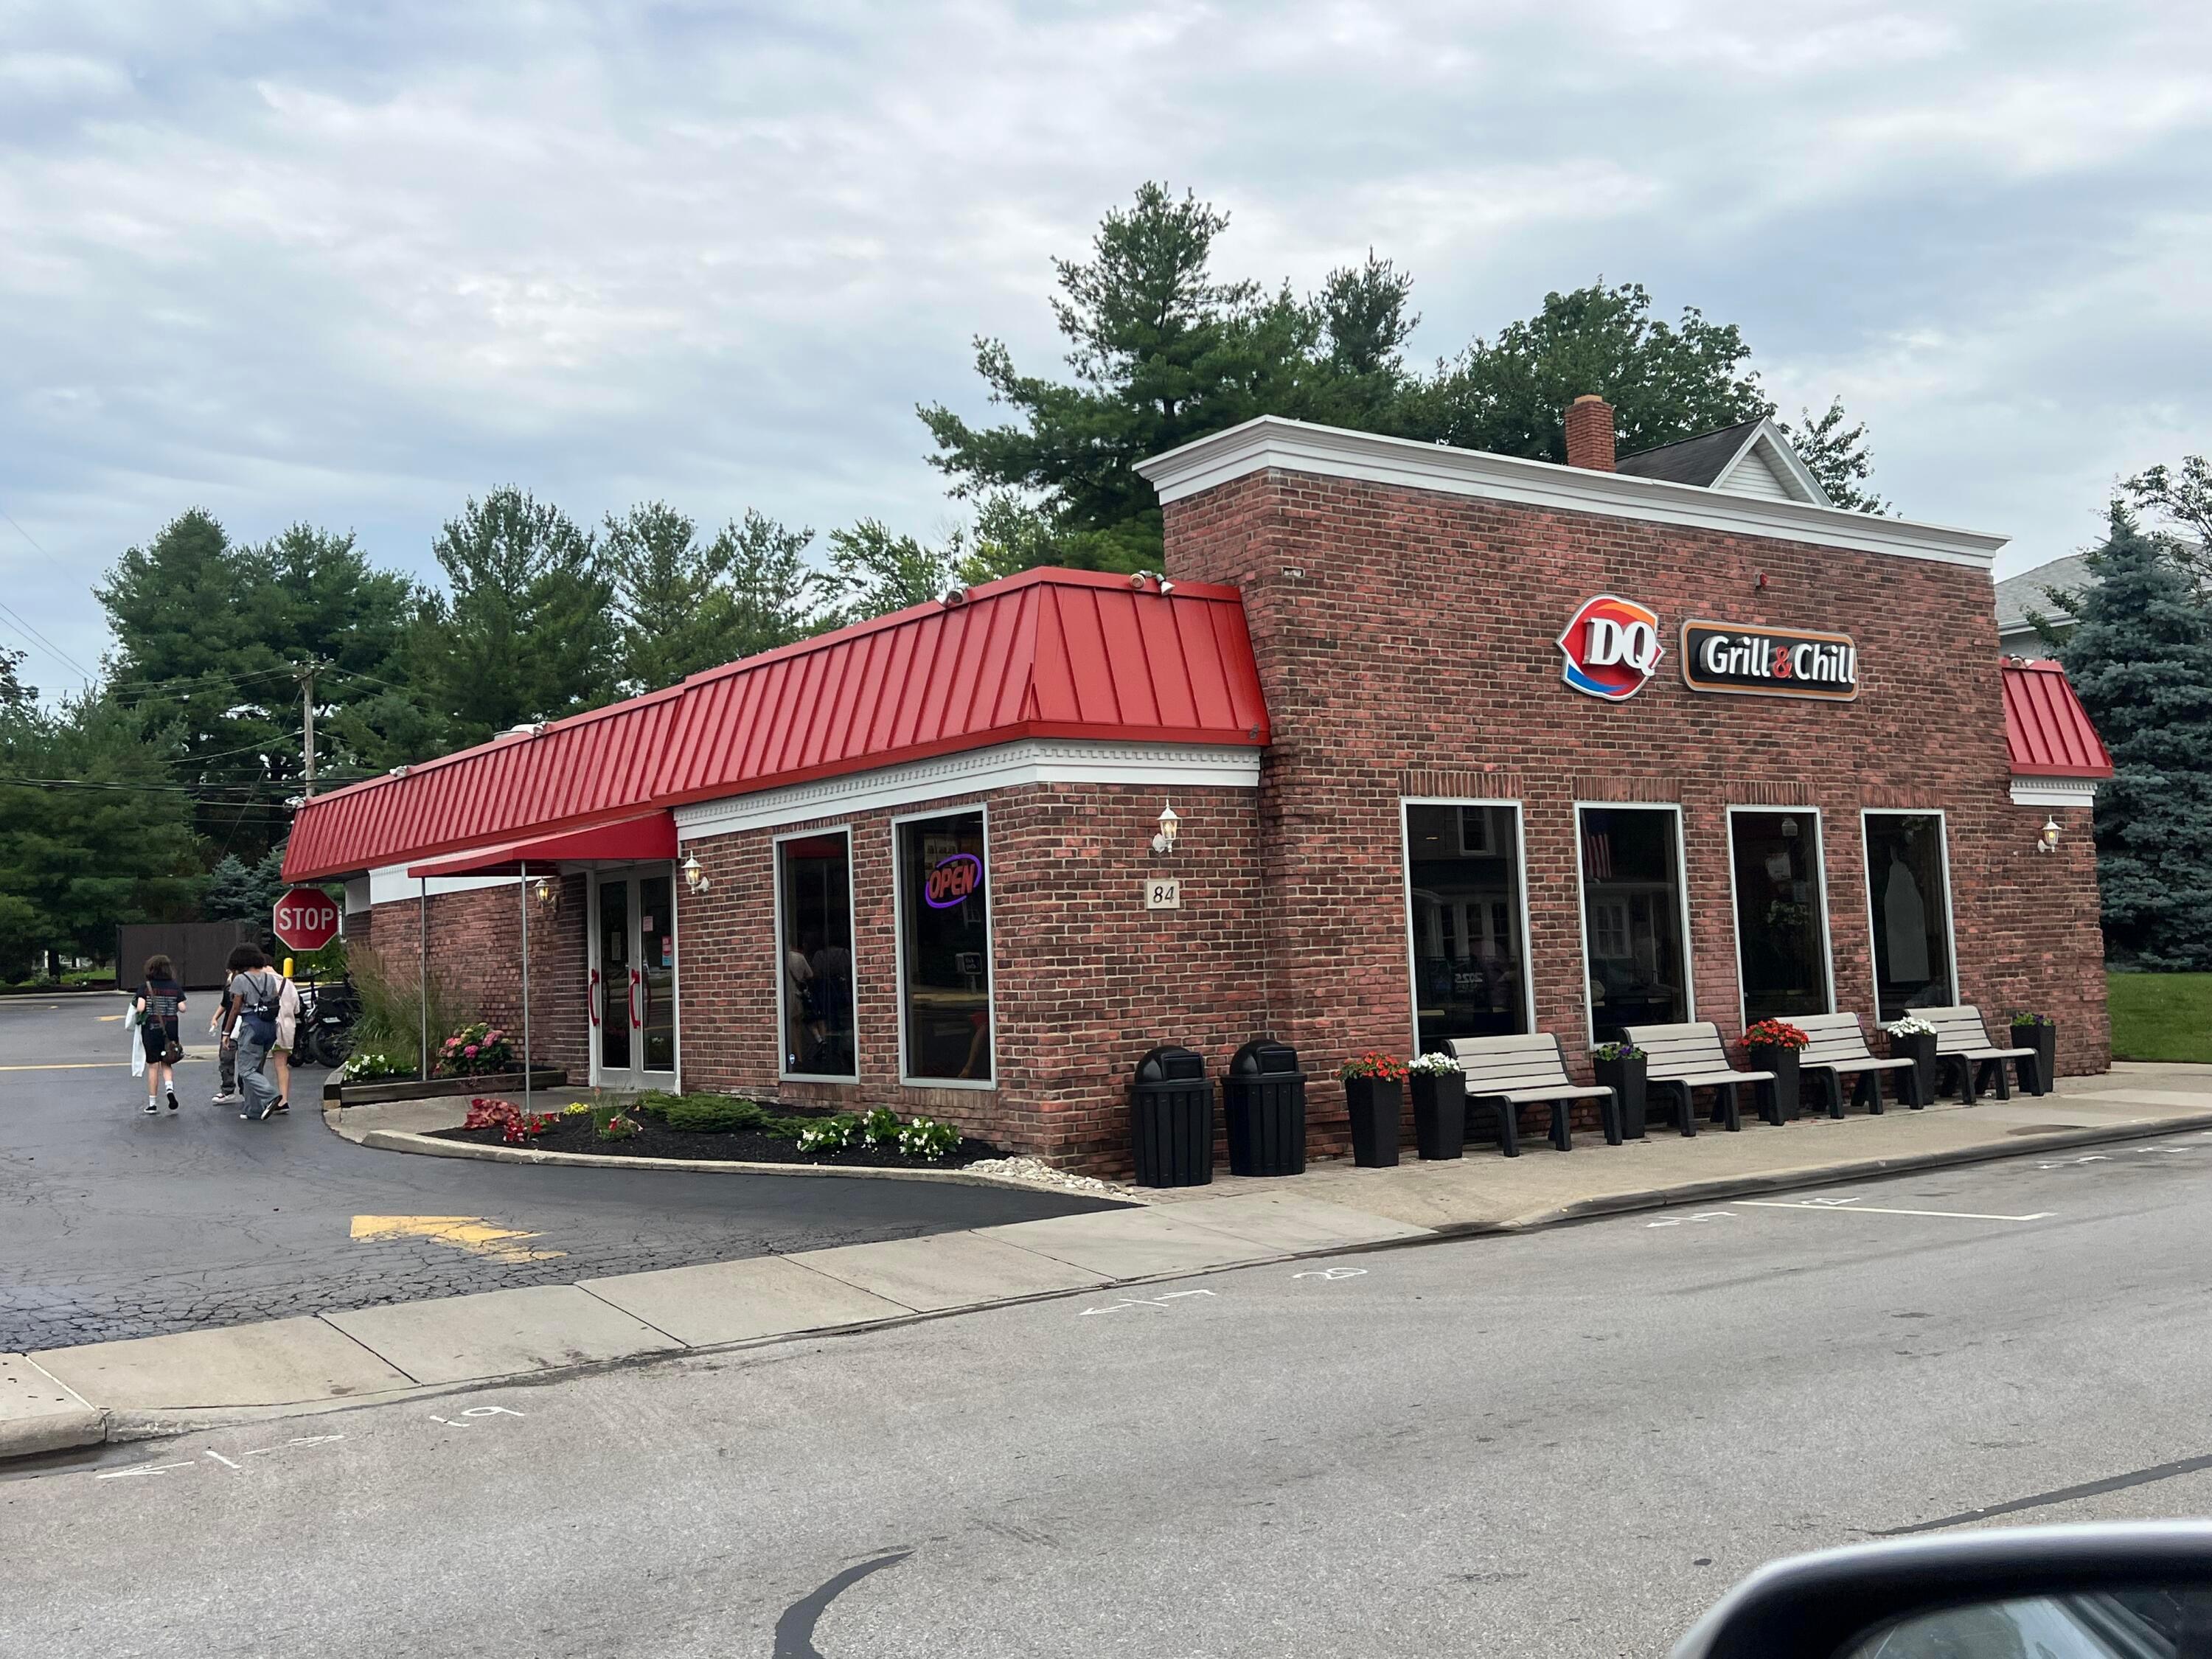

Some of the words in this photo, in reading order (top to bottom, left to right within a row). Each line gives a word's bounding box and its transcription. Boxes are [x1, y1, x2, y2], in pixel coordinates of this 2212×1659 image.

[1585, 618, 1656, 676] DQ
[929, 863, 975, 899] OPEN
[1153, 886, 1175, 903] 84
[278, 908, 334, 931] STOP
